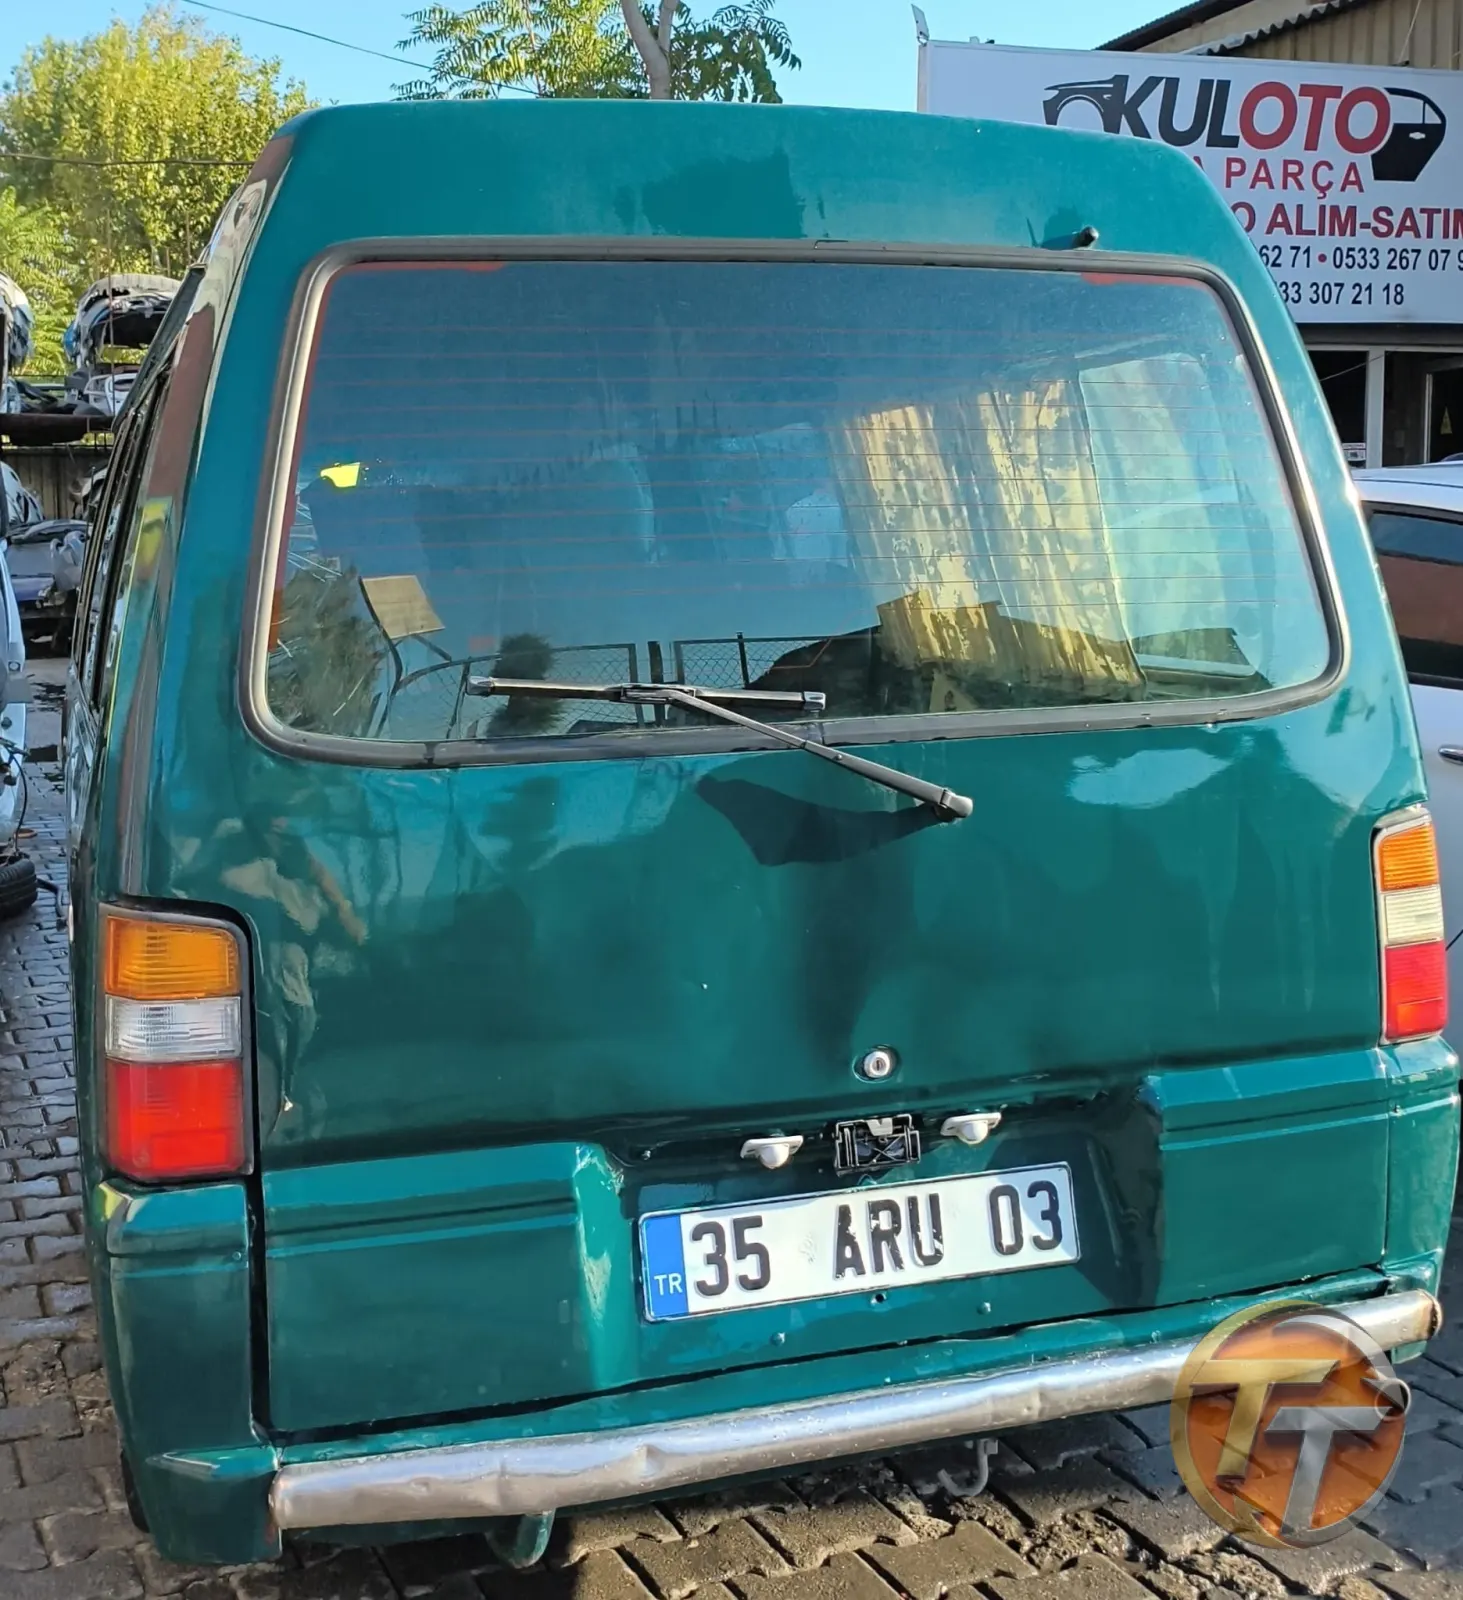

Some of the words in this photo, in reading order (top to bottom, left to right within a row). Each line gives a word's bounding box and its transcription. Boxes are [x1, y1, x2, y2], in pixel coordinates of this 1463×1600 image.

[1225, 157, 1365, 199] PARÇA
[1290, 246, 1311, 268] 71
[1333, 246, 1380, 270] 0533
[1386, 247, 1422, 271] 267
[1428, 249, 1451, 271] 07
[1275, 281, 1301, 304] 33
[1309, 282, 1345, 305] 307
[1351, 282, 1372, 305] 21
[1382, 283, 1404, 305] 18
[691, 1215, 770, 1297] 35
[834, 1192, 945, 1281] ARU
[988, 1179, 1063, 1256] 03
[654, 1272, 683, 1297] TR
